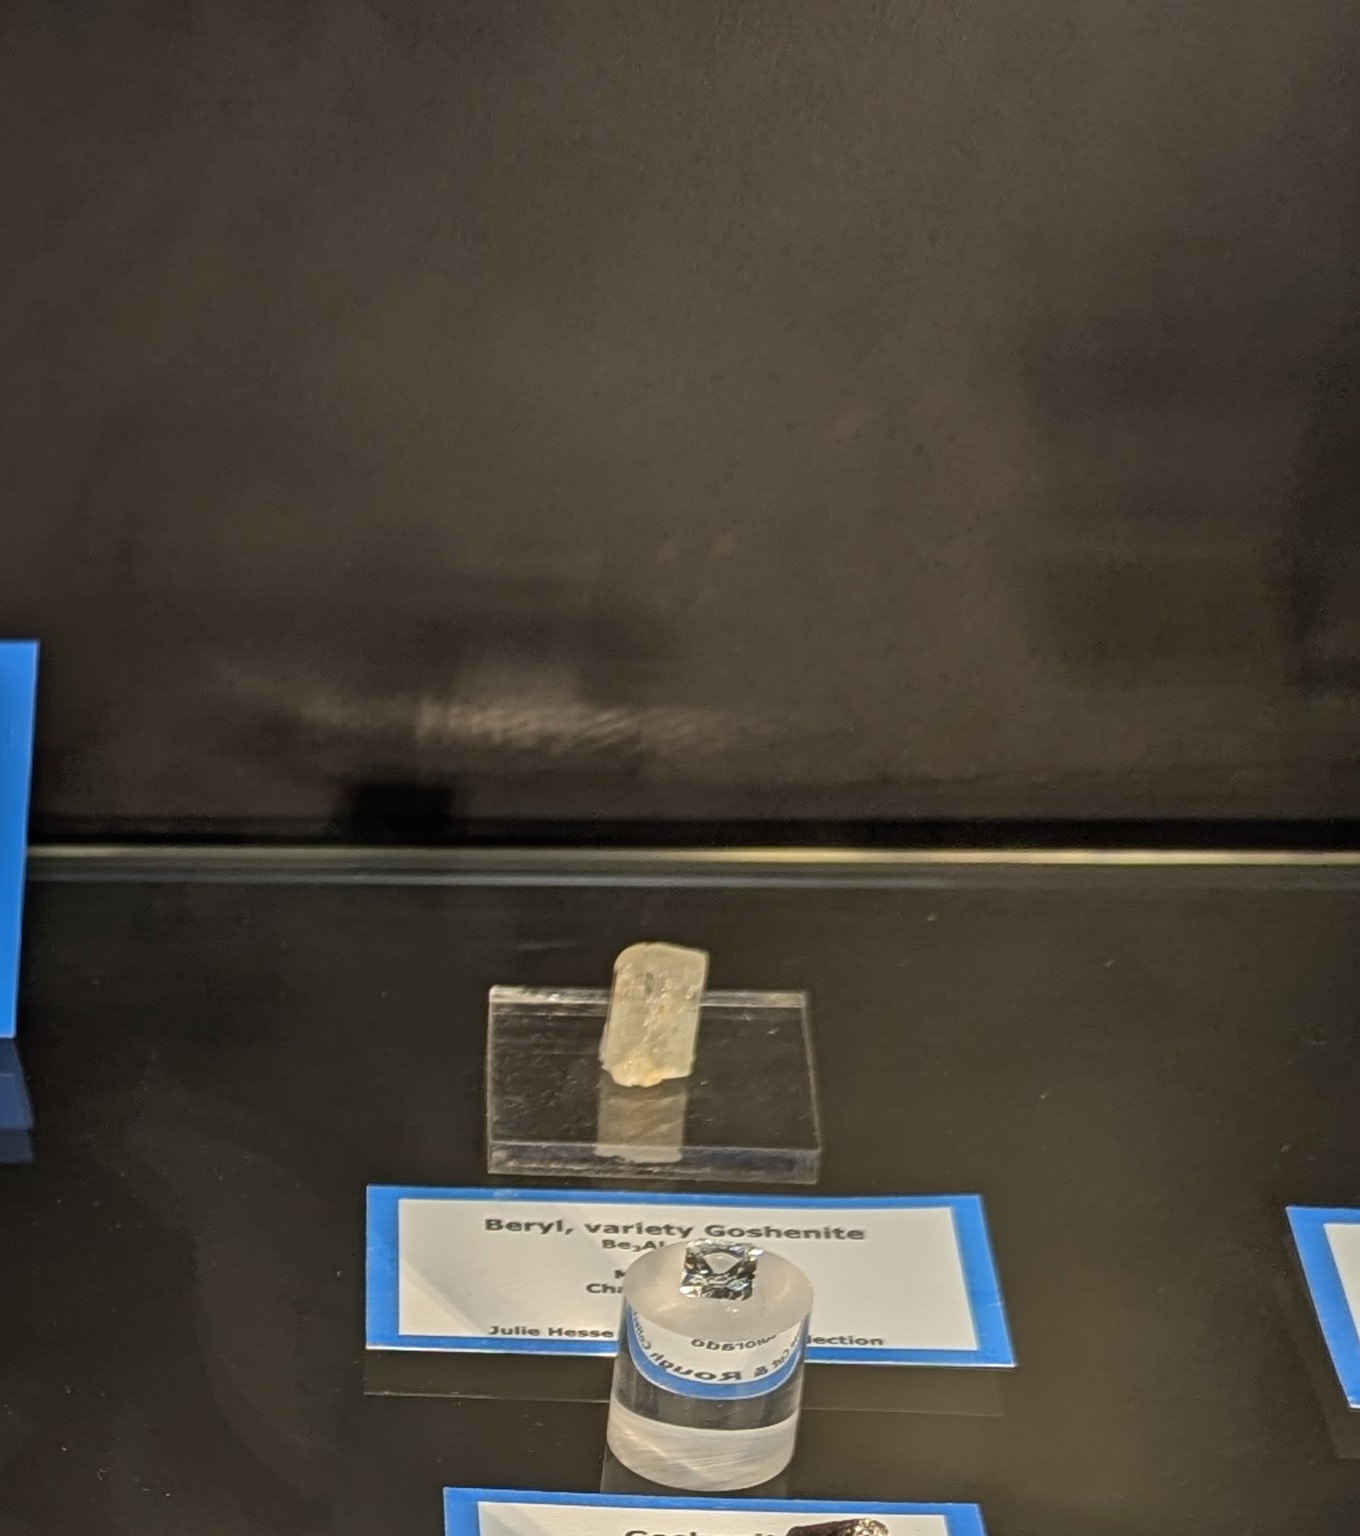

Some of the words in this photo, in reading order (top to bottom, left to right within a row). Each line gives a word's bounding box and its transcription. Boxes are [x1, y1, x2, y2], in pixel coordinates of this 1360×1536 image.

[485, 1218, 575, 1235] Beryl,
[585, 1220, 693, 1239] variety
[704, 1224, 866, 1240] Goshenite
[487, 1325, 540, 1337] Julie
[548, 1326, 614, 1338] Hesse
